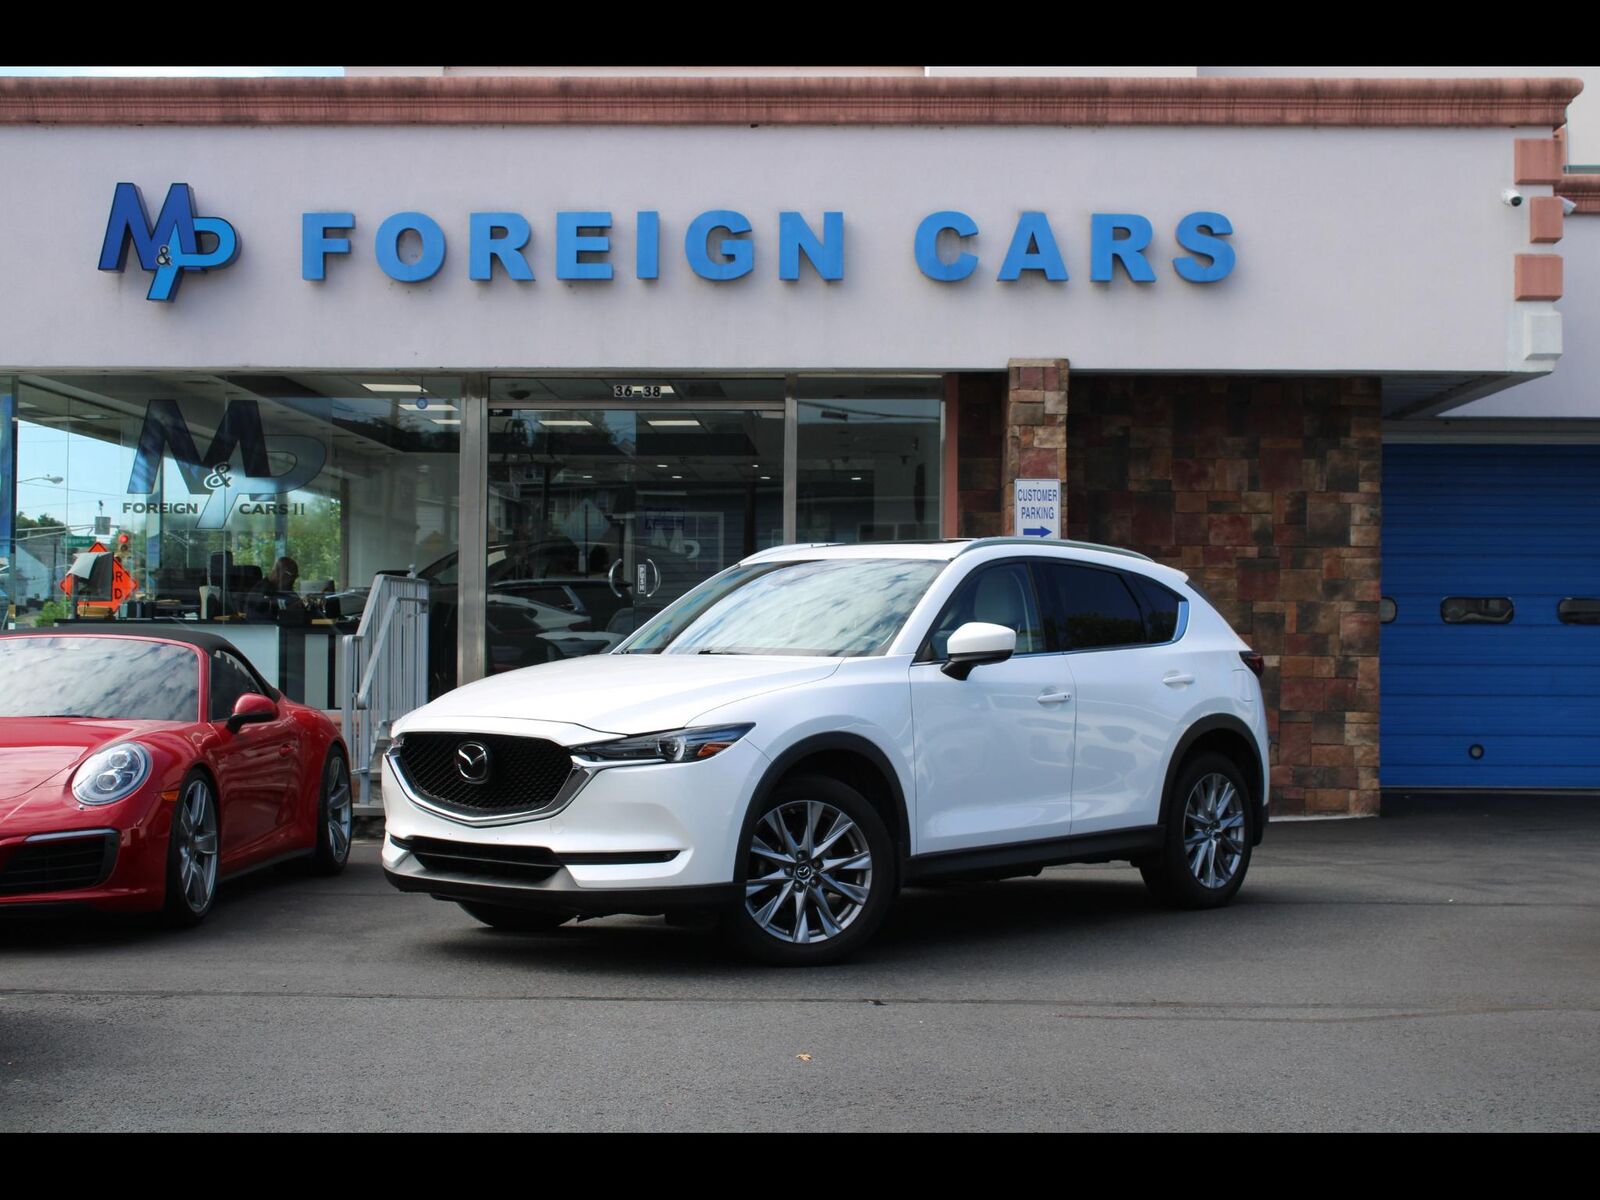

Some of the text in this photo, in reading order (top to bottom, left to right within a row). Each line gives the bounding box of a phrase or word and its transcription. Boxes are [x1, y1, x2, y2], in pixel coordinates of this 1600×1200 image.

[302, 210, 847, 282] FOREIGN
[914, 210, 1237, 283] CARS
[615, 384, 661, 398] 36-38
[1017, 488, 1058, 502] CUSTOMER
[122, 502, 199, 514] FOREIGN
[238, 502, 289, 515] CARS
[1021, 506, 1055, 520] PARKING
